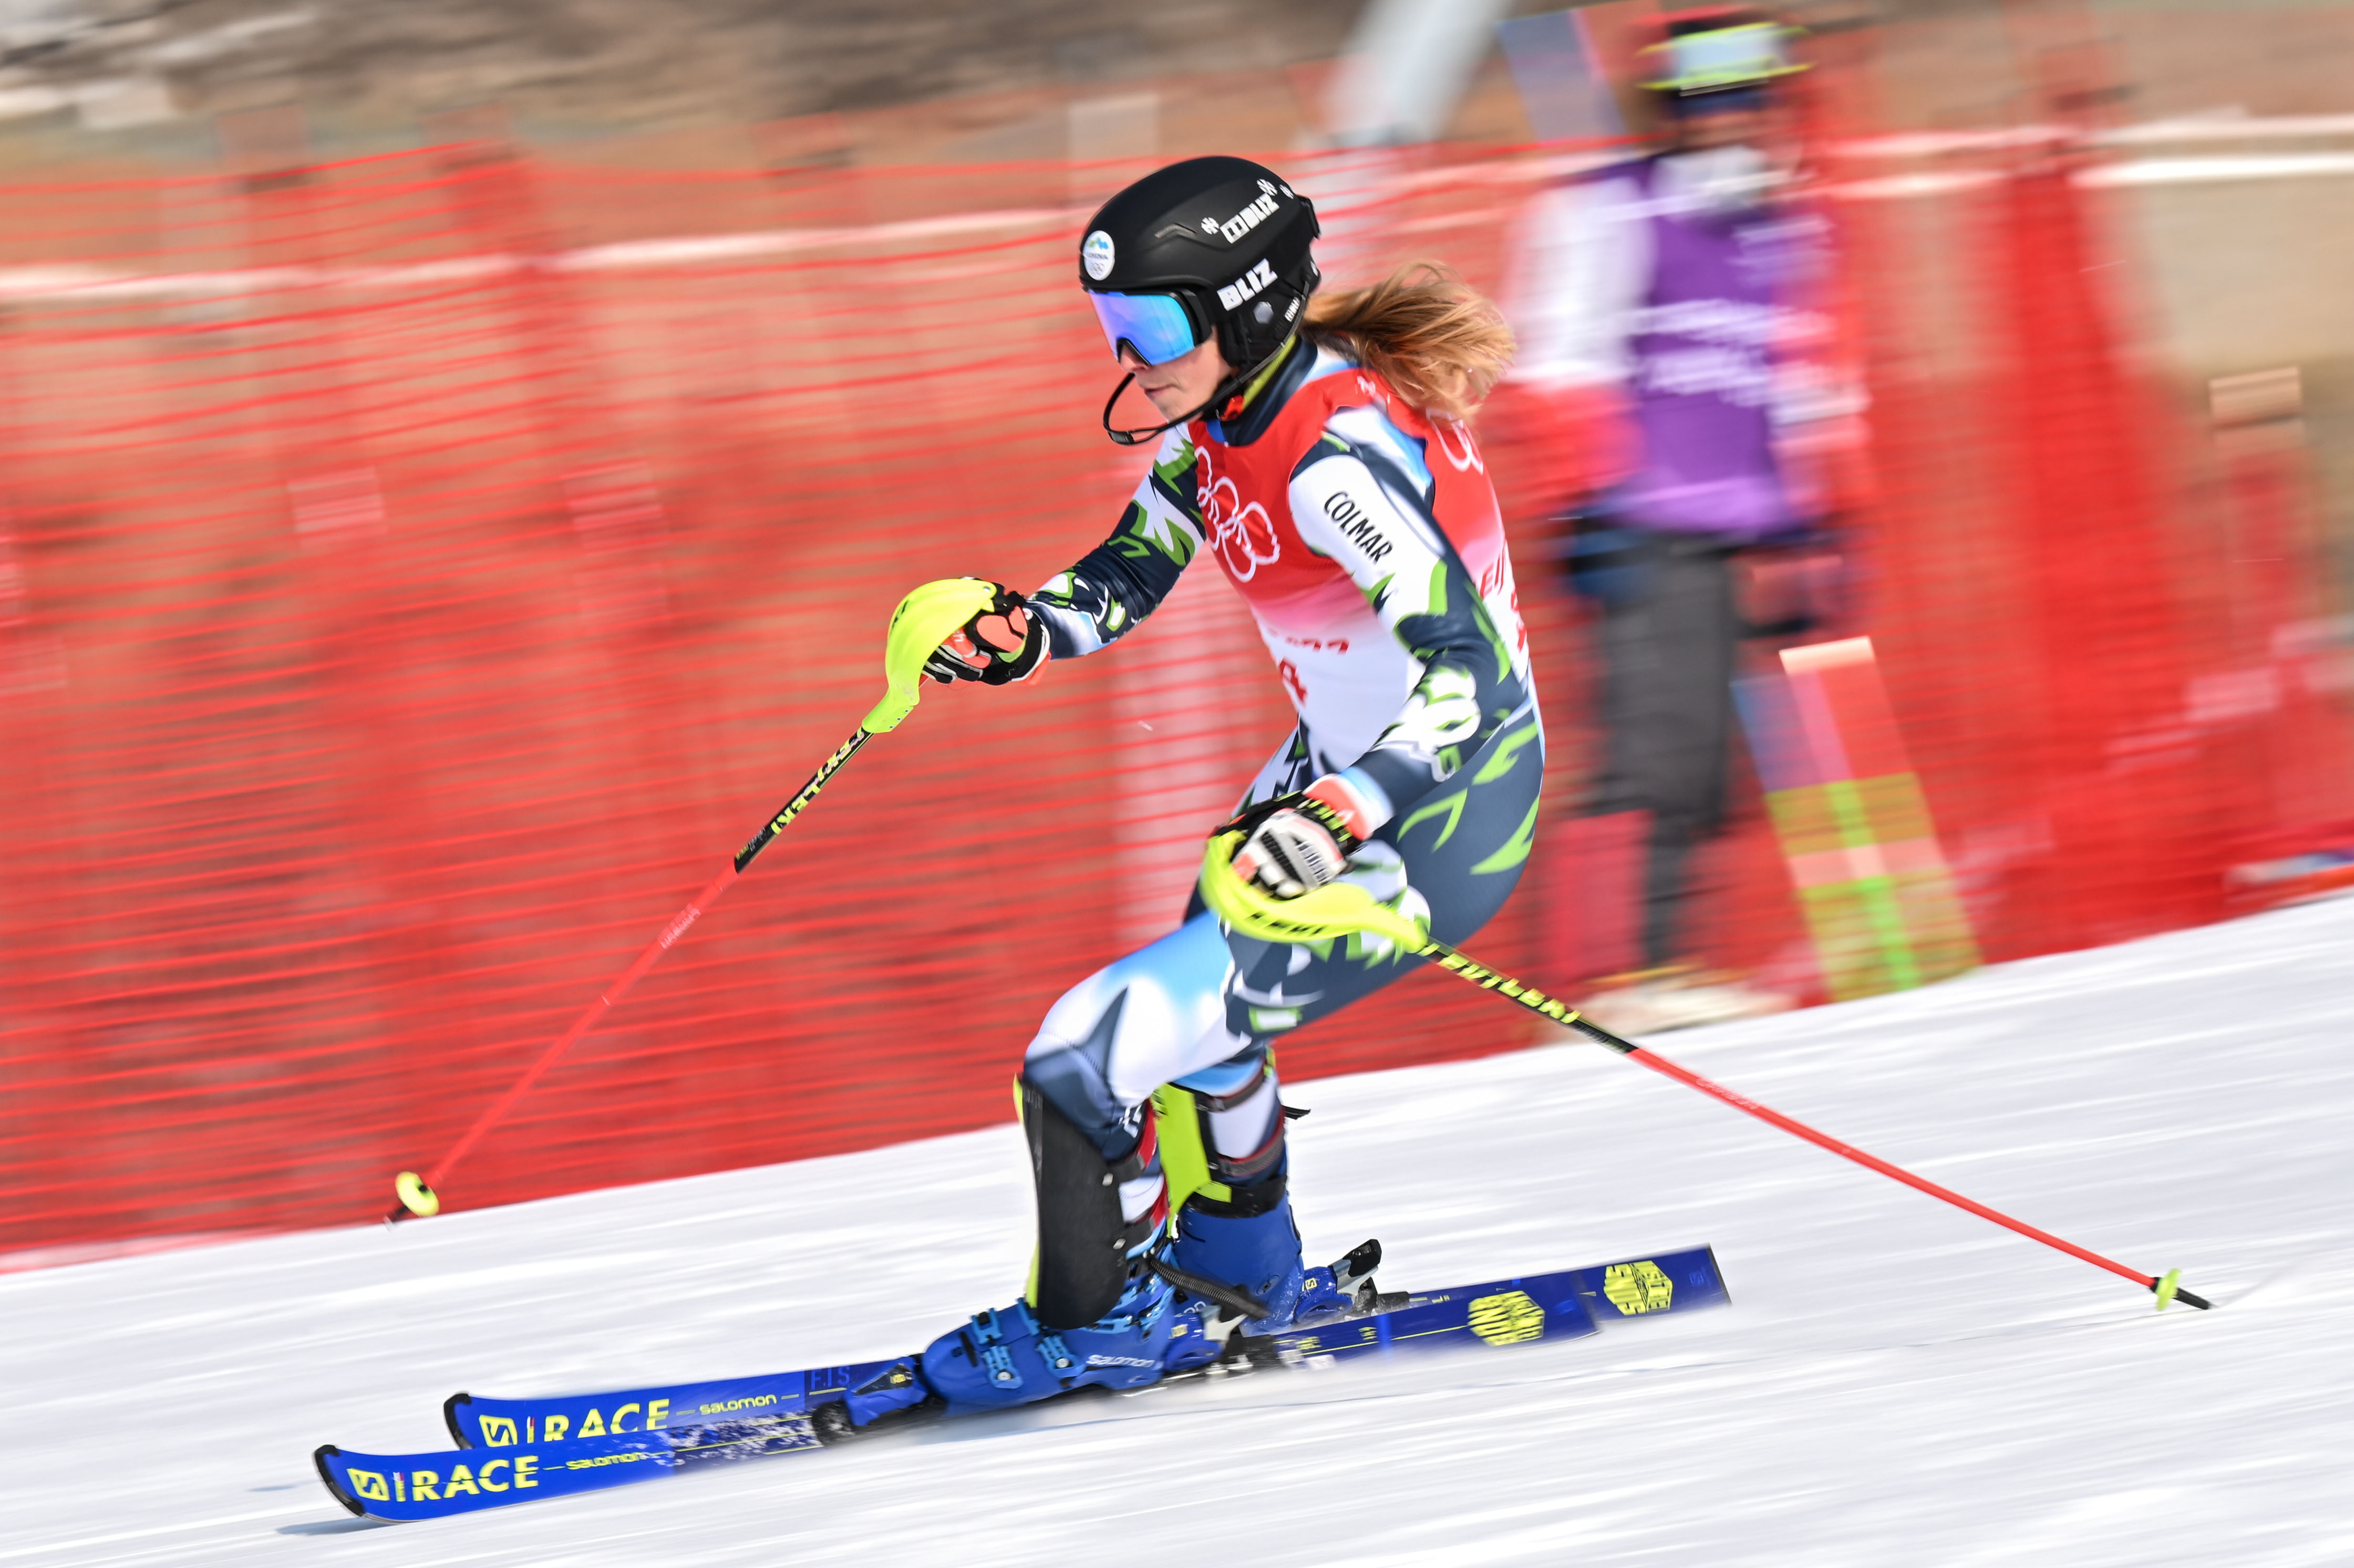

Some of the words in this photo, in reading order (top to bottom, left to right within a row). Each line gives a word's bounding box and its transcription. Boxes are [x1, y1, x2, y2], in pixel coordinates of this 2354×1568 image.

[1216, 258, 1278, 311] BLIZ
[1324, 490, 1393, 564] COLMAR
[811, 1366, 850, 1389] FIS
